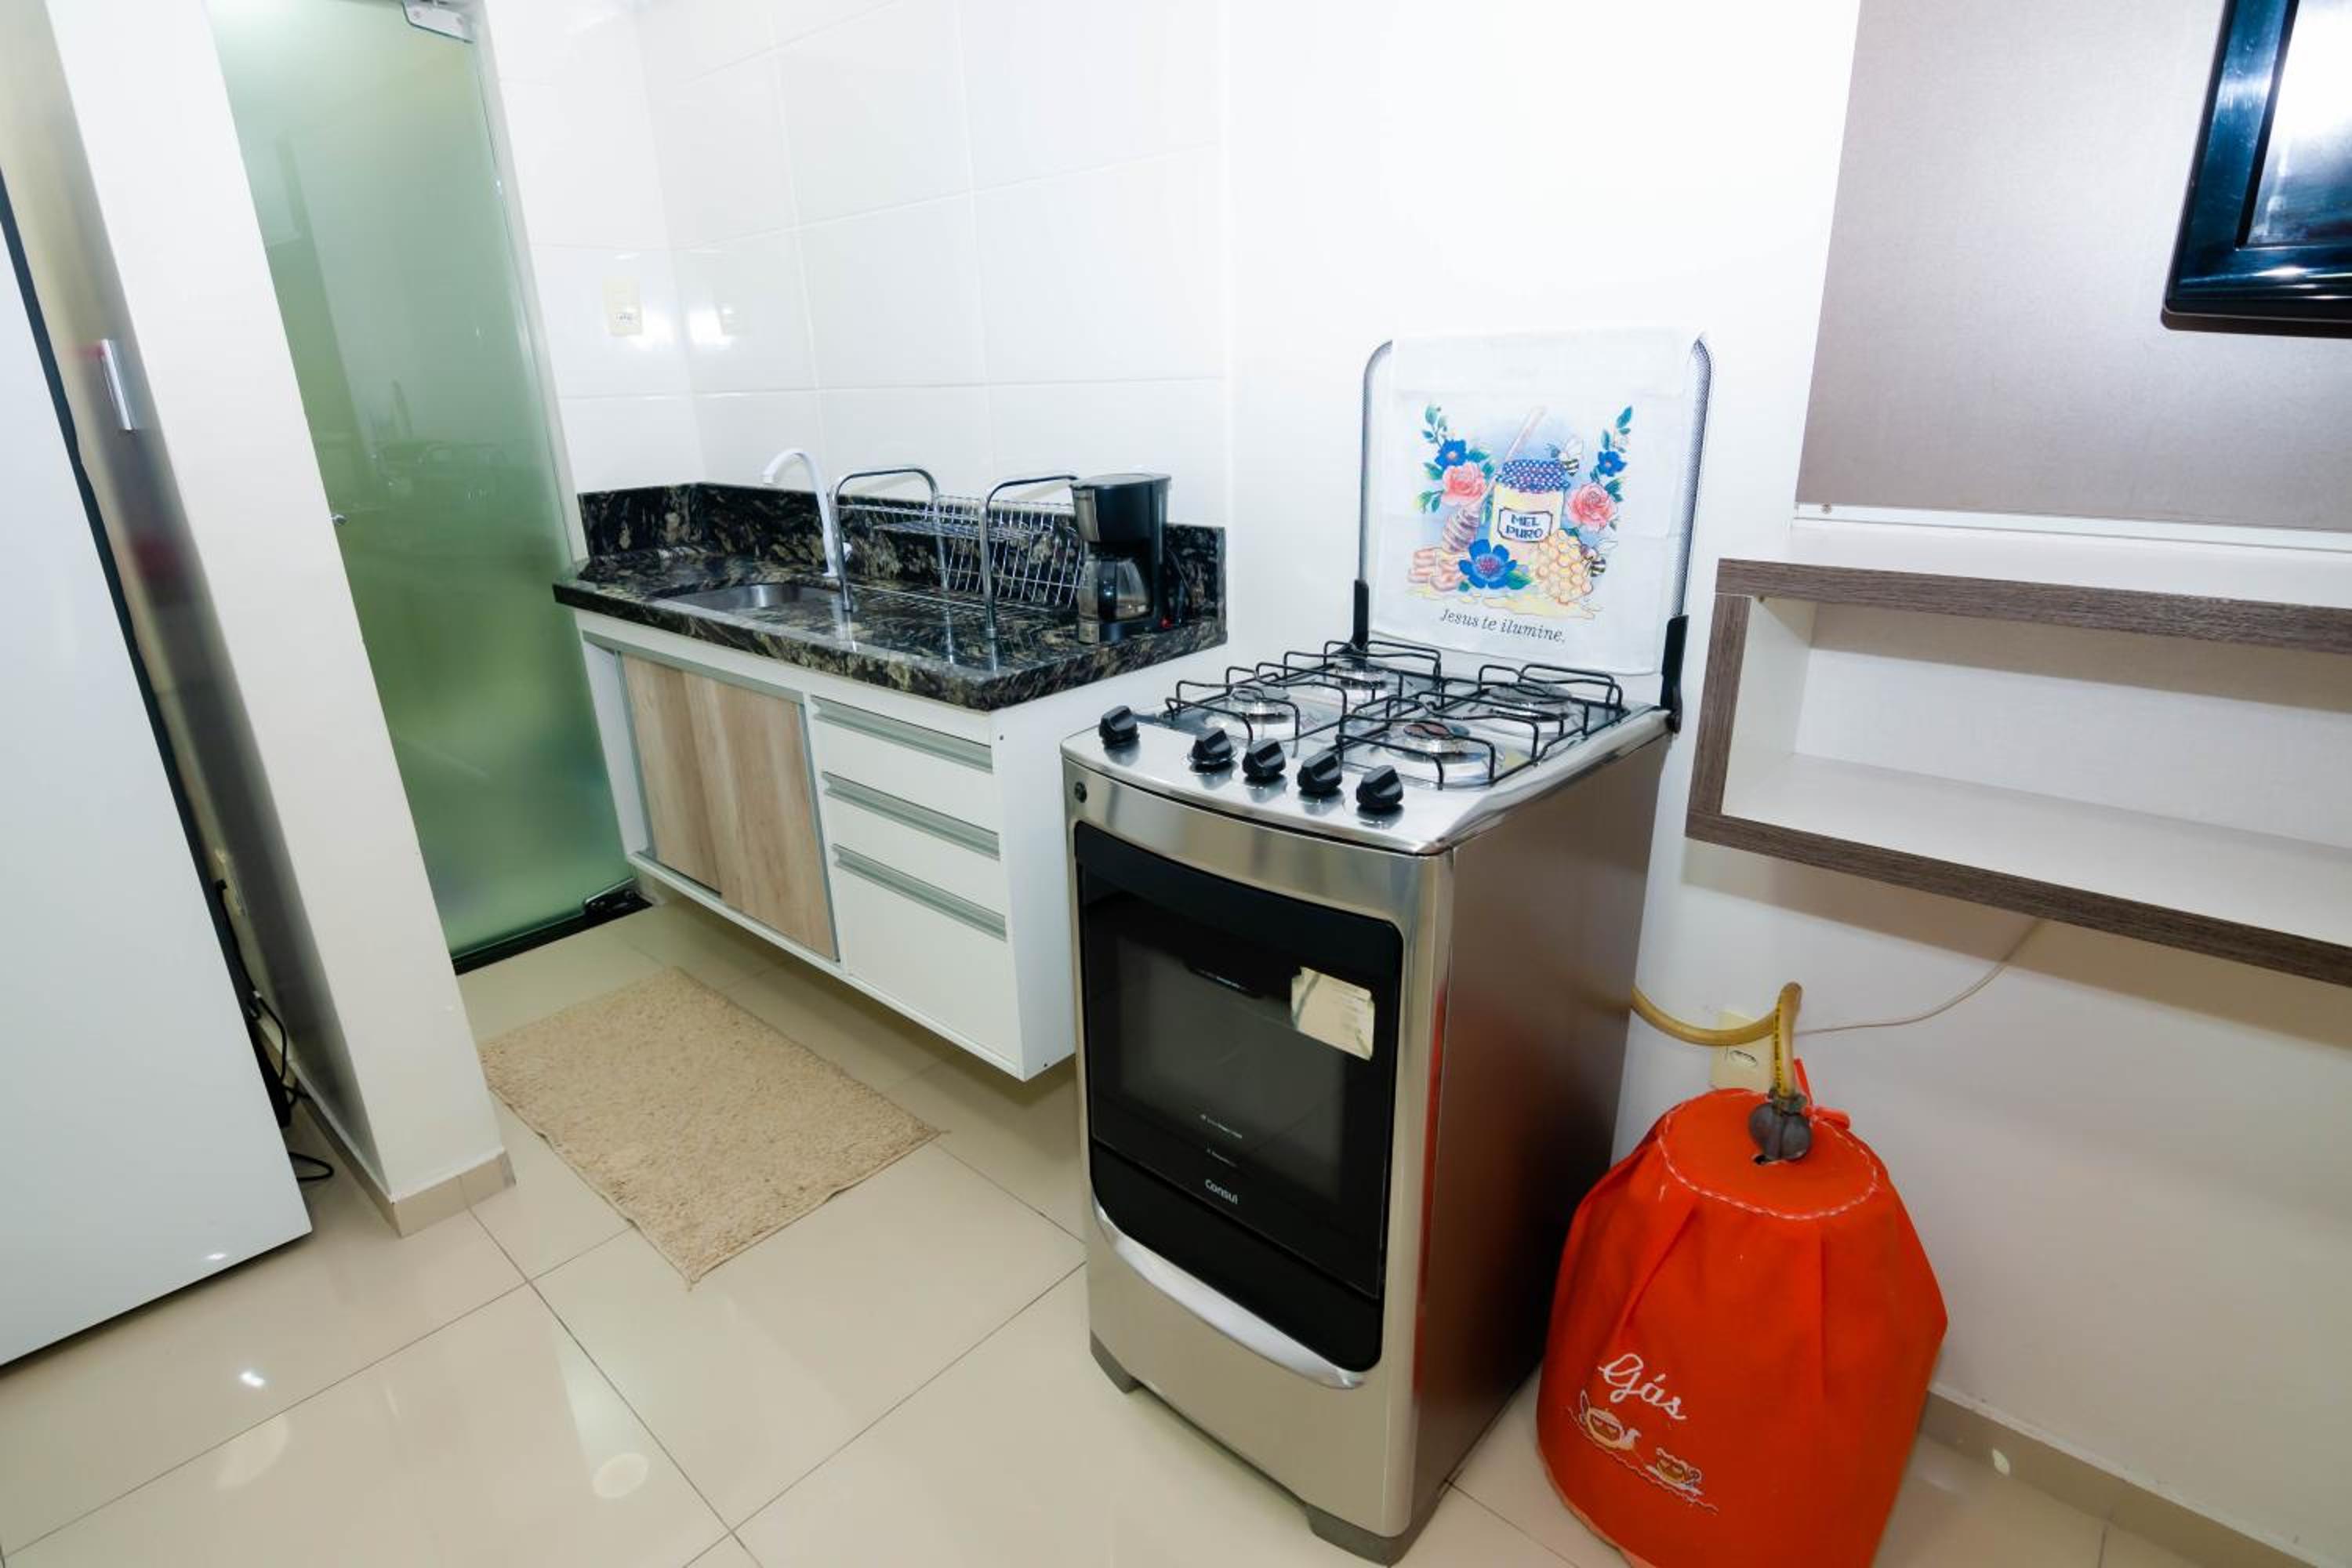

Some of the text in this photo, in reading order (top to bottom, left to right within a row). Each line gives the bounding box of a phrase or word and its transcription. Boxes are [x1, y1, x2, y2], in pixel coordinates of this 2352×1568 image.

[1506, 524, 1544, 539] PURO
[1511, 514, 1540, 527] MEL
[1440, 608, 1479, 628] Jesus
[1481, 615, 1497, 632] te
[1205, 1178, 1238, 1204] Consul
[1597, 1352, 1687, 1420] Gás
